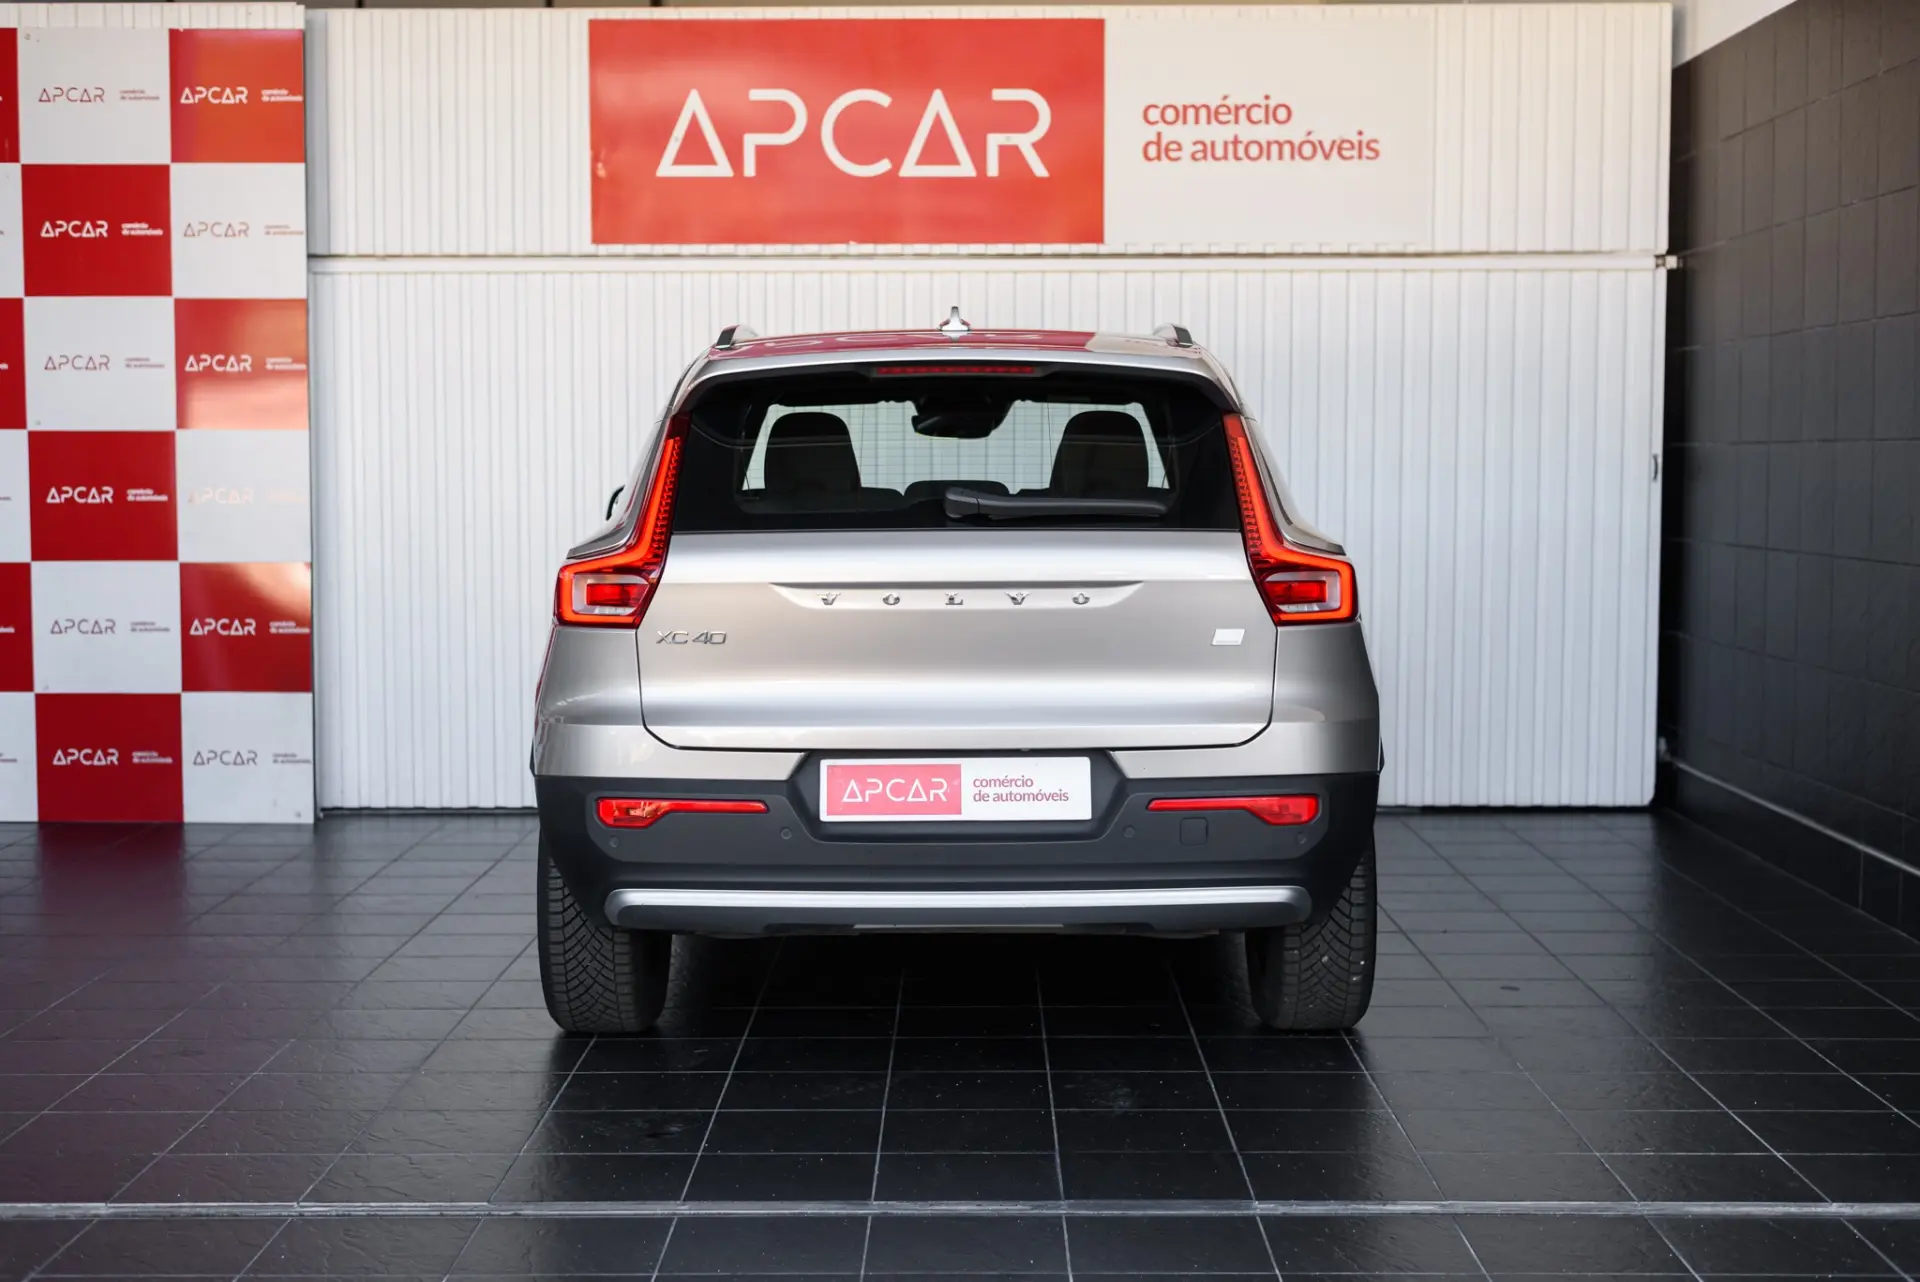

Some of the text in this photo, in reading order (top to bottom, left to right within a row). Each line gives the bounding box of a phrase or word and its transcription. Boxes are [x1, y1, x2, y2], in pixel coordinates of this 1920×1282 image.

[38, 87, 105, 103] APCAR
[180, 86, 249, 104] APCAR
[1142, 94, 1293, 126] comércio
[656, 88, 1052, 178] APCAR
[1142, 129, 1381, 162] de automóveis
[40, 220, 108, 238] APCAR
[183, 221, 250, 238] APCAR
[44, 354, 111, 371] APCAR
[184, 354, 252, 373] APCAR
[46, 486, 114, 504] APCAR
[816, 592, 1091, 606] VOLVO
[50, 618, 116, 635] APCAR
[189, 618, 257, 636] APCAR
[52, 748, 119, 766] APCAR
[192, 750, 258, 767] APCAR
[841, 778, 948, 803] APCAR
[972, 775, 1034, 789] comércio
[972, 788, 1070, 803] de automóveis
